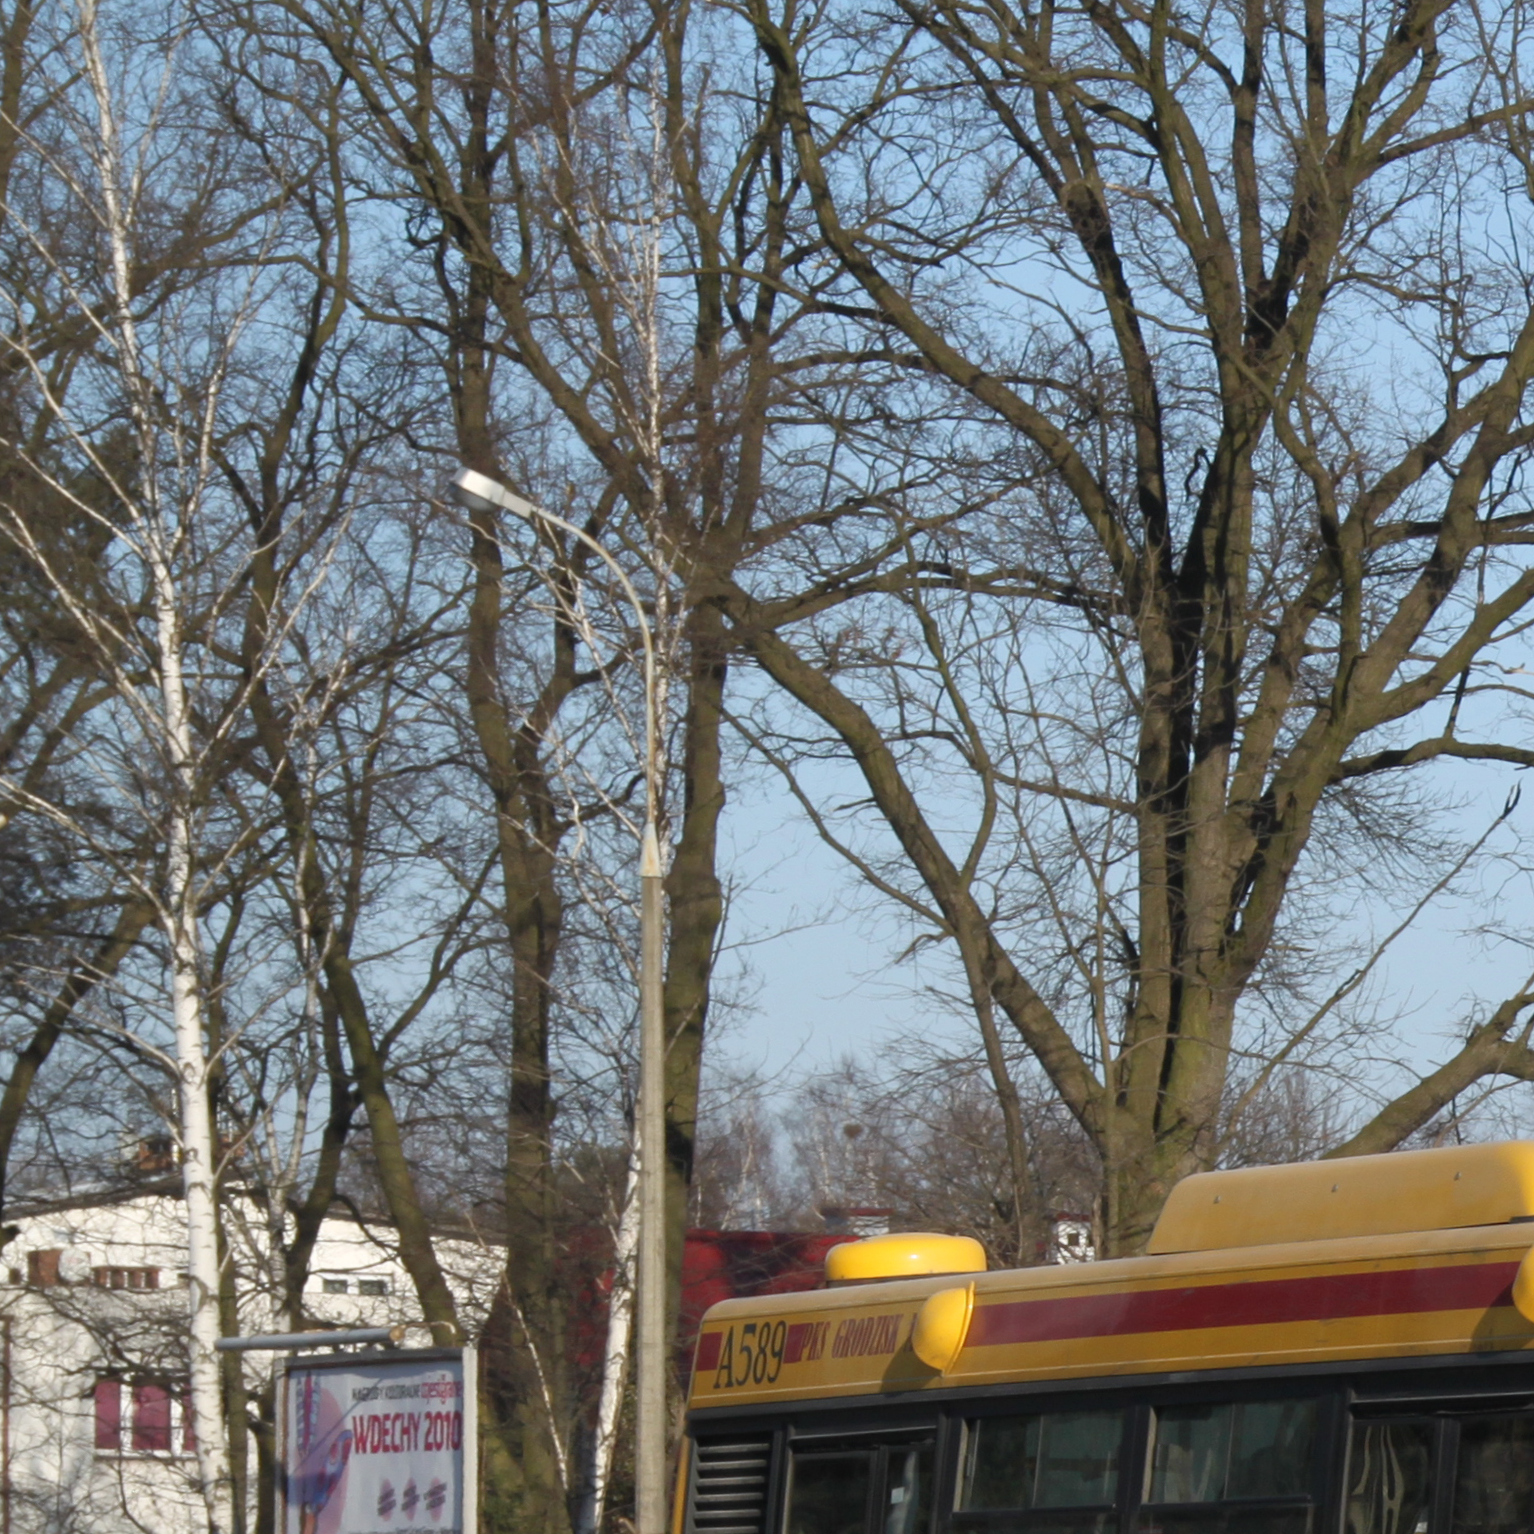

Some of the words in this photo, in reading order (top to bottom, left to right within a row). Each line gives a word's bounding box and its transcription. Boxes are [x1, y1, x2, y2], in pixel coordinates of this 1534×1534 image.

[713, 1320, 787, 1389] A589
[352, 1412, 421, 1454] WDECHY
[424, 1410, 463, 1452] 2010
